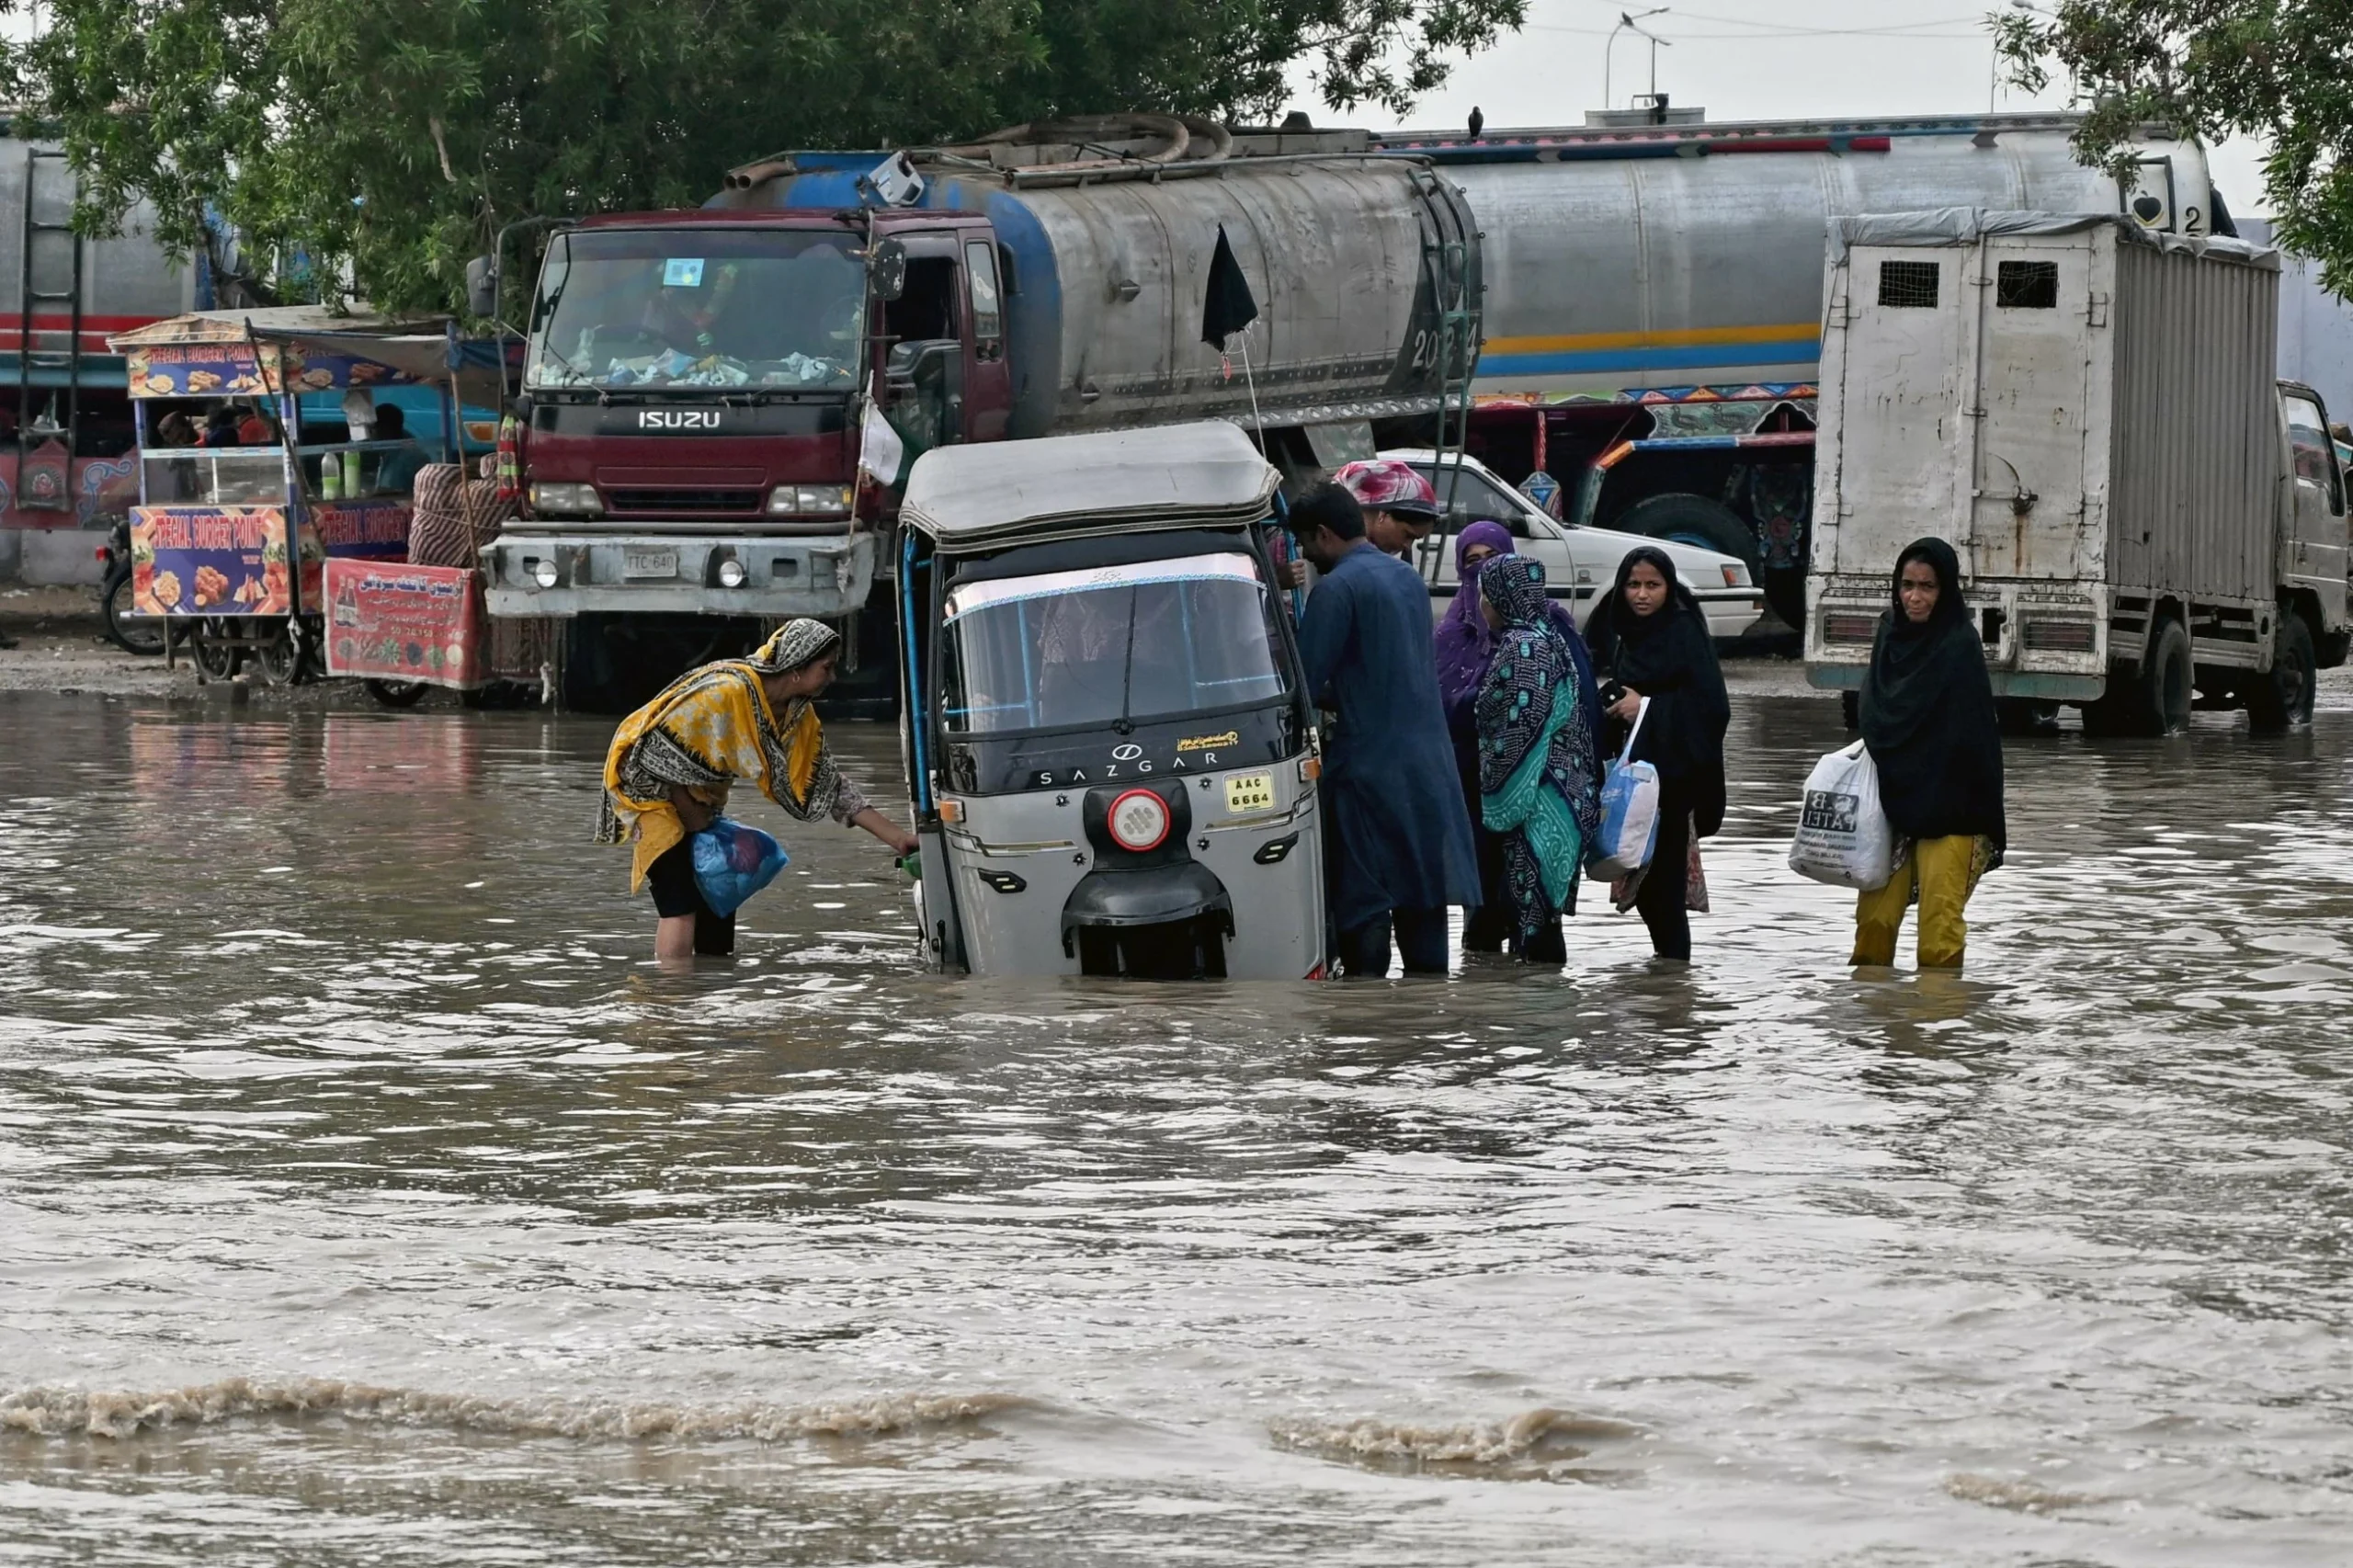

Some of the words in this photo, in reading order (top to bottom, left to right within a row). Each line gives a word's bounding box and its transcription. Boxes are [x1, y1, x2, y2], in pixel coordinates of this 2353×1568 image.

[150, 346, 185, 364] SPECIAL
[187, 345, 226, 364] BURGER
[639, 412, 721, 428] ISUZU
[154, 516, 192, 550] SPECIAL
[193, 515, 233, 551] BURGER
[233, 515, 263, 550] POINT
[324, 509, 363, 546] SPECIAL
[1040, 753, 1217, 785] SAZGAR
[1235, 778, 1261, 790] AAC
[1232, 793, 1268, 806] 6664
